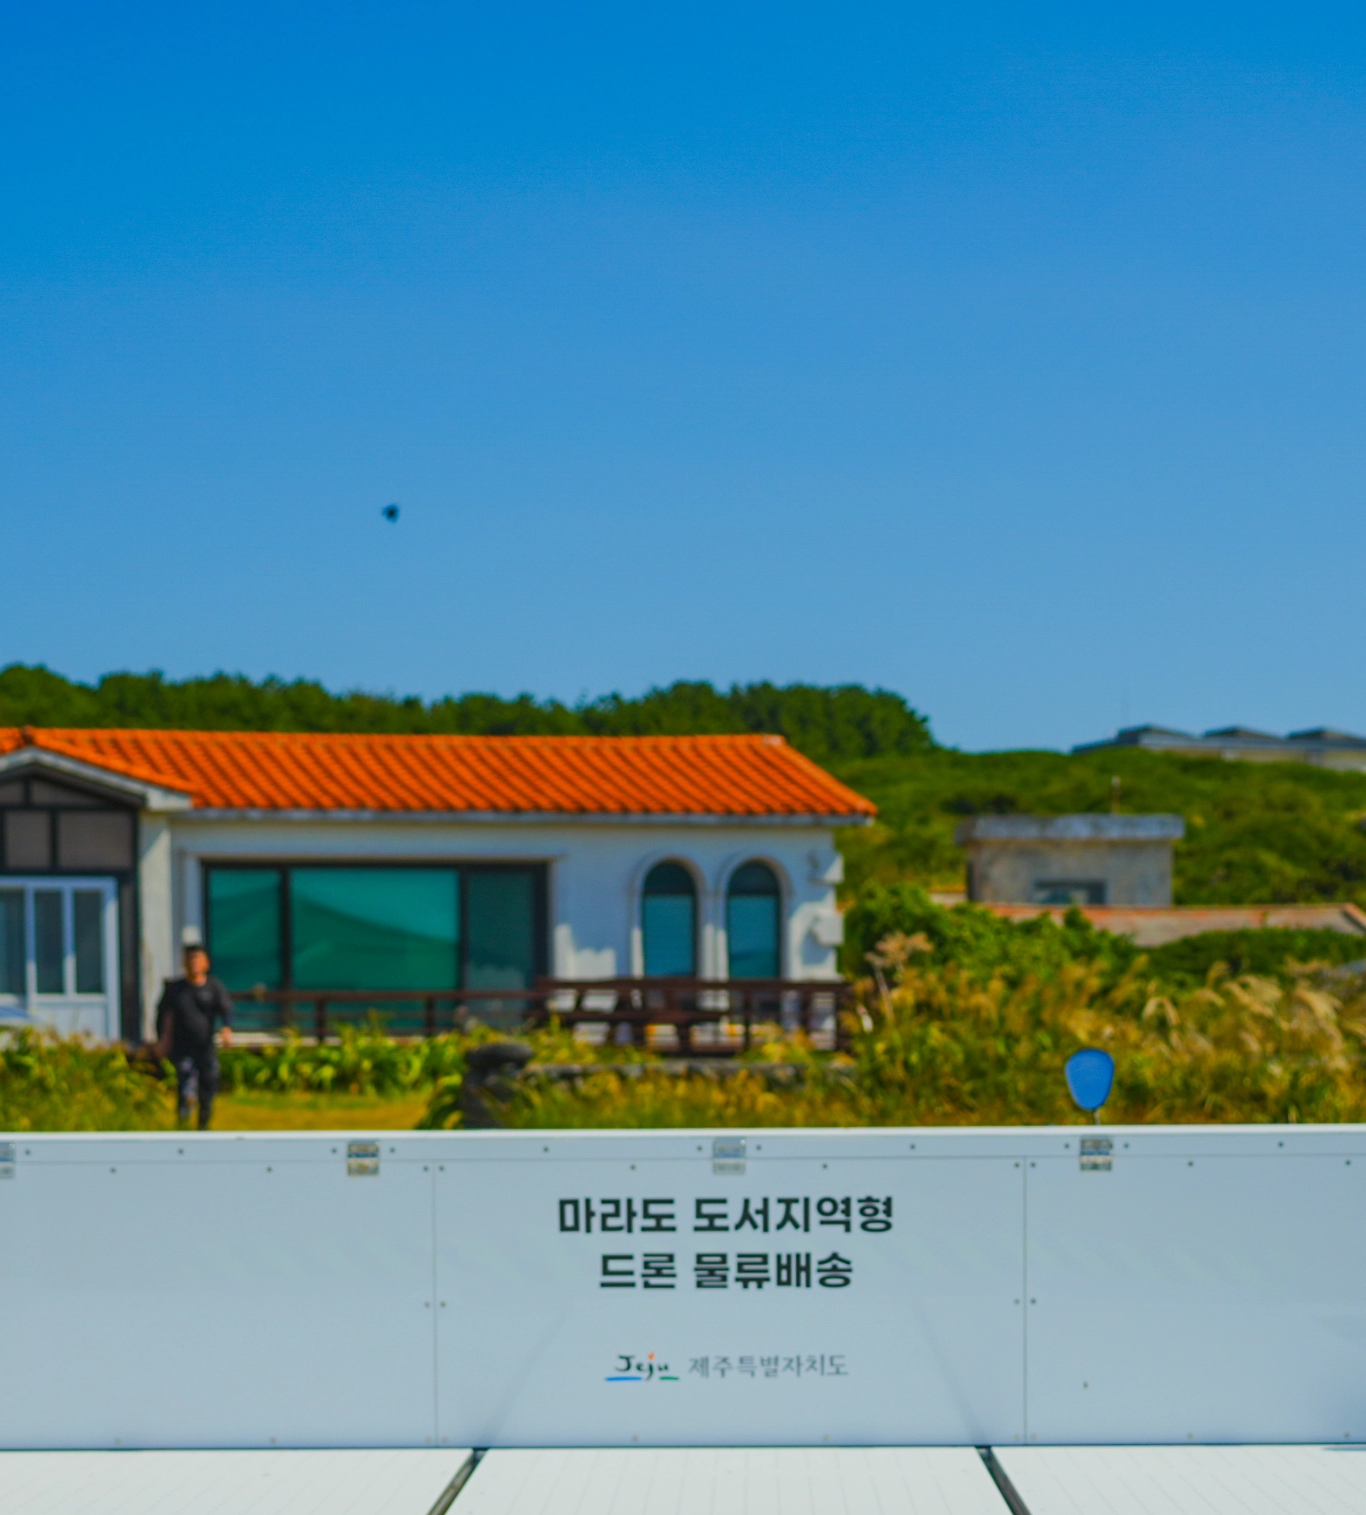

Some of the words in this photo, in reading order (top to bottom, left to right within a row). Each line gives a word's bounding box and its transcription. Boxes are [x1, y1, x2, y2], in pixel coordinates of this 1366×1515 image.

[558, 1197, 677, 1234] 마라도
[693, 1195, 893, 1234] 도서지역형
[599, 1252, 677, 1289] 드론
[694, 1251, 854, 1289] 물류배송
[614, 1352, 670, 1381] Jeju
[688, 1353, 849, 1378] 제주특별자치도
